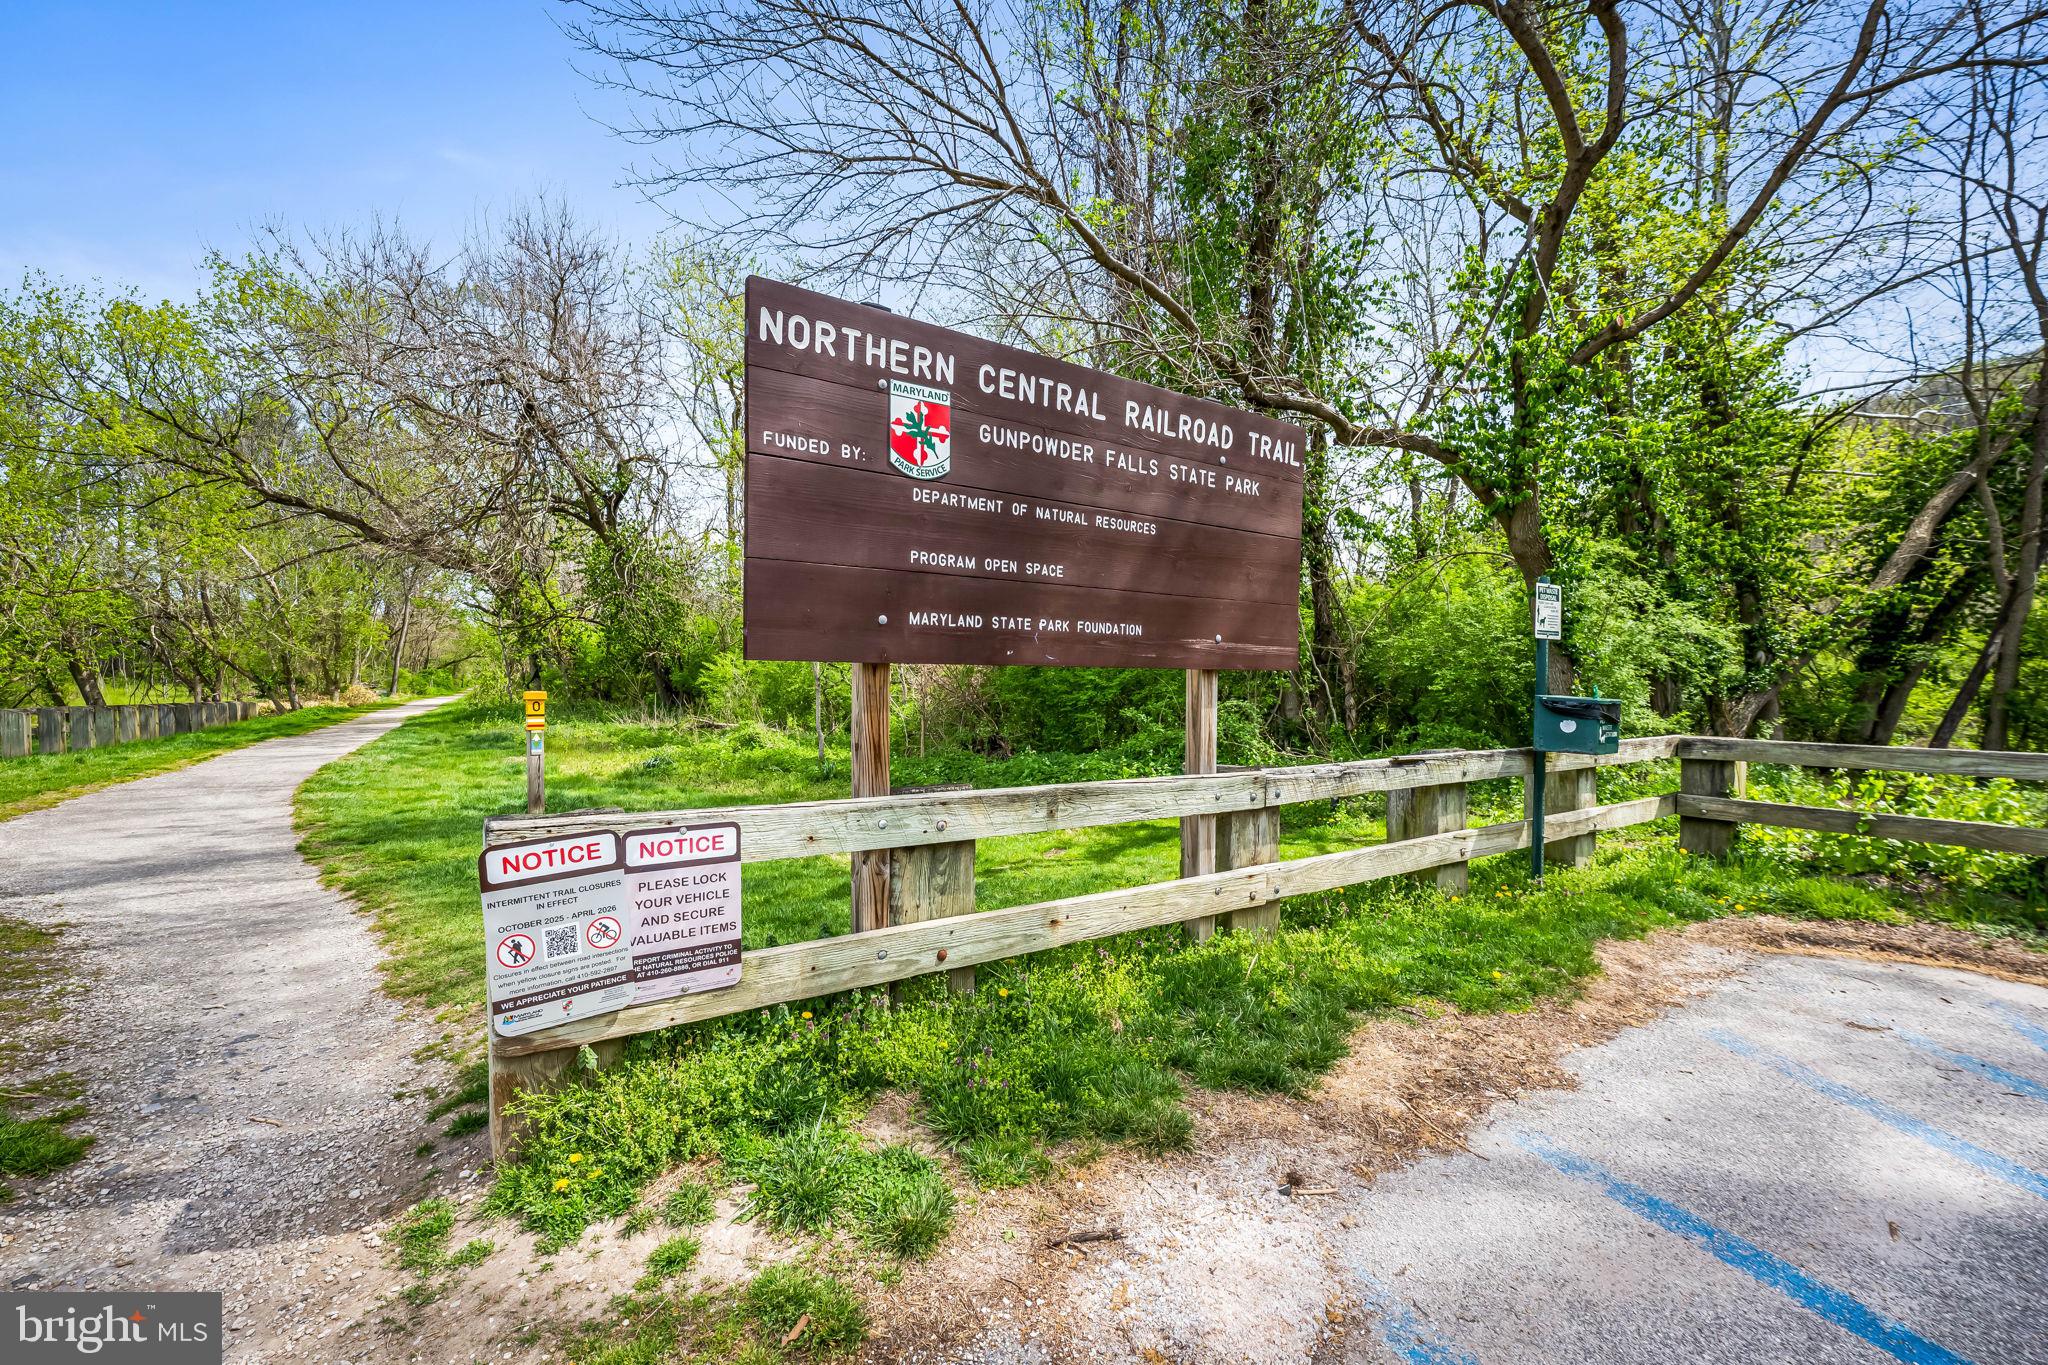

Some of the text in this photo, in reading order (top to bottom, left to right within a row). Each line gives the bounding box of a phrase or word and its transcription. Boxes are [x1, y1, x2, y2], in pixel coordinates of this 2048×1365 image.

[759, 306, 1300, 467] NORTHERN CENTRAL RAILROAD TRAIL
[893, 382, 948, 402] MARYLAND
[763, 430, 866, 461] FUNDED BY:
[894, 457, 947, 477] PARK SERVICE
[979, 424, 1260, 497] GUNPOWDER FALLS STATE PARK
[913, 487, 1157, 535] DEPARTMENT OF NATURAL RESOURCES
[910, 550, 1064, 577] PROGRAM OPEN SPACE
[909, 611, 1142, 636] MARYLAND STATE PARK FOUNDATION
[502, 842, 602, 875] NOTICE
[639, 834, 725, 859] NOTICE
[487, 879, 622, 910] INTERMITTENT TRAIL CLOSURES
[638, 872, 727, 892] PLEASE LOCK
[536, 896, 578, 910] IN EFFECT
[635, 888, 730, 910] YOUR VEHICLE
[497, 918, 542, 934] OCTOBER
[544, 914, 565, 925] 2025
[571, 908, 596, 919] APRIL
[597, 904, 617, 915] 2026
[640, 906, 725, 928] AND SECURE
[630, 921, 737, 947] VALUABLE ITEMS
[493, 971, 522, 981] Closures
[531, 963, 549, 972] effect
[549, 958, 576, 969] between
[577, 954, 591, 963] road
[591, 947, 629, 959] intersections
[633, 955, 661, 966] REPORT
[661, 951, 694, 961] CRIMINAL
[694, 946, 723, 955] ACTIVITY
[642, 961, 674, 971] NATURAL
[674, 953, 715, 965] RESOURCES
[715, 949, 738, 957] POLICE
[702, 959, 718, 967] DIAL
[497, 980, 516, 989] when
[516, 976, 537, 987] yellow
[538, 970, 560, 980] closure
[562, 966, 579, 976] signs
[591, 959, 612, 969] posted.
[508, 988, 526, 996] more
[564, 974, 576, 982] call
[501, 1002, 515, 1011] WE
[516, 987, 567, 1007] APPRECIATE
[567, 982, 590, 994] YOUR
[591, 974, 627, 989] PATIENCE
